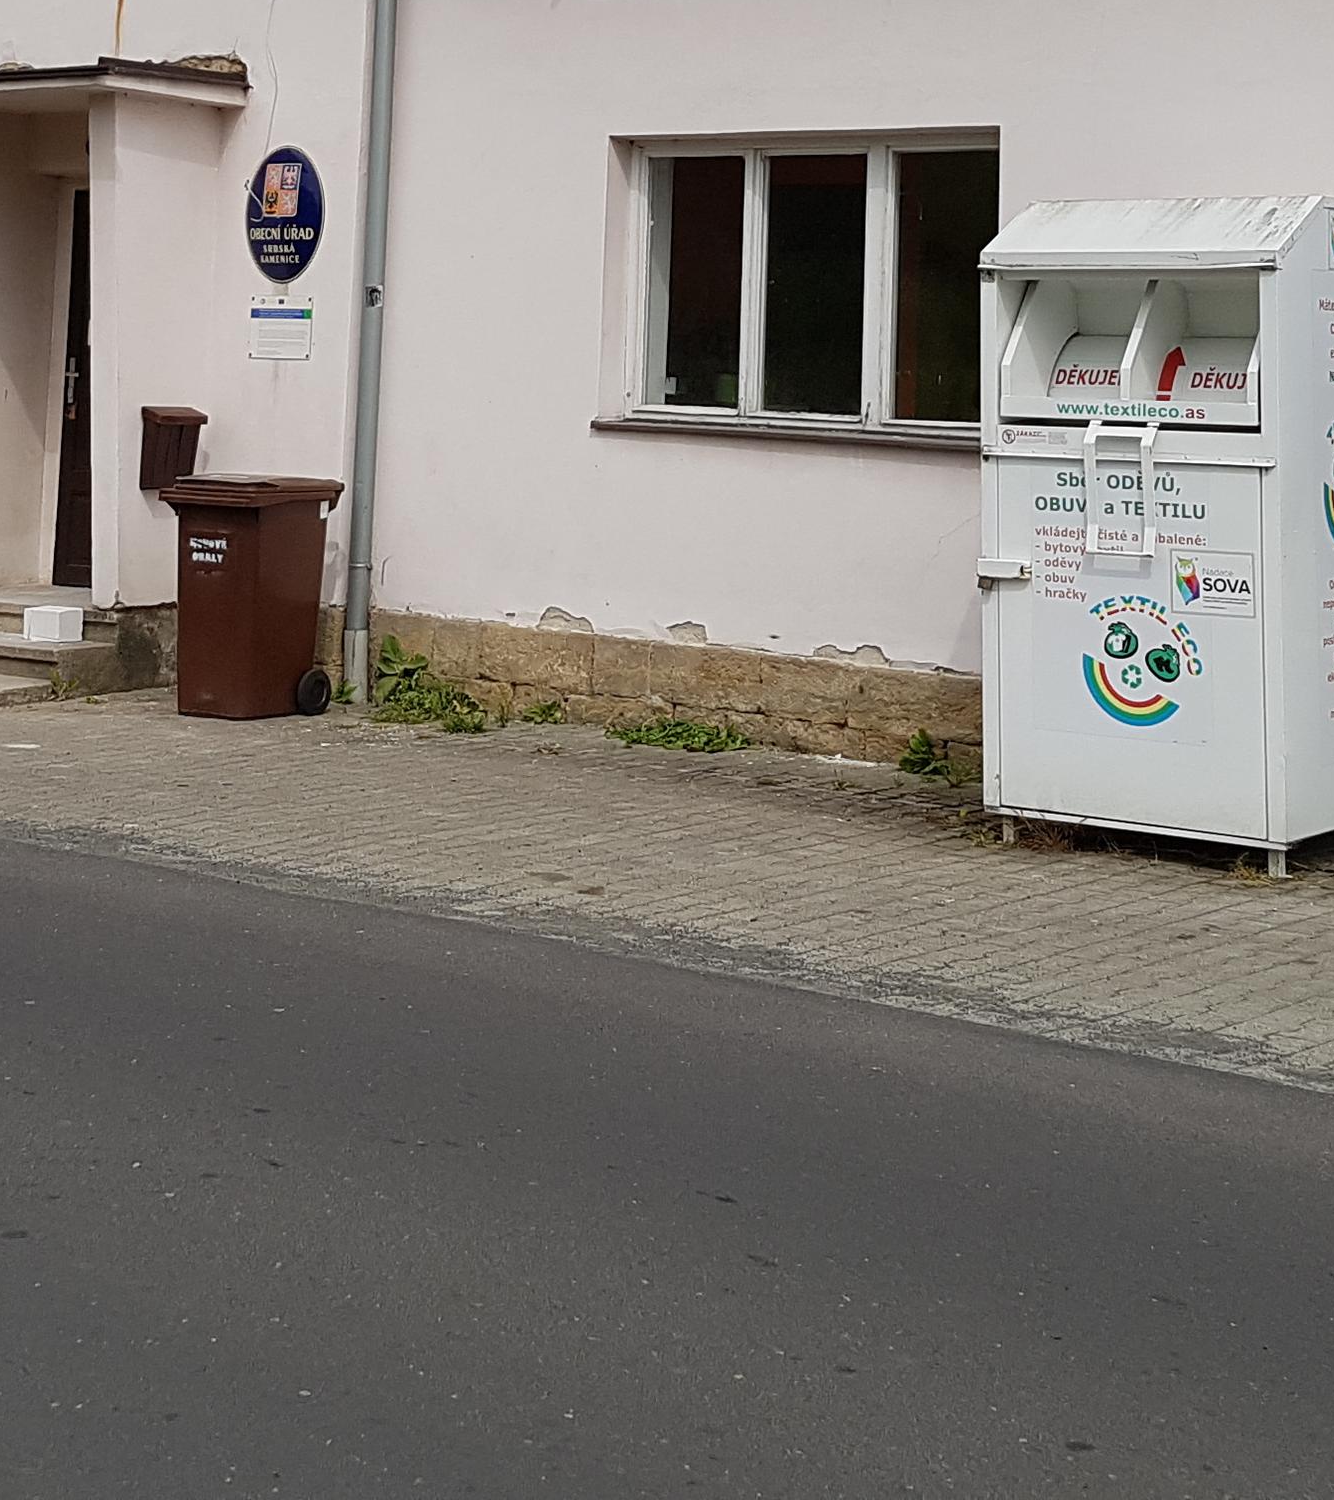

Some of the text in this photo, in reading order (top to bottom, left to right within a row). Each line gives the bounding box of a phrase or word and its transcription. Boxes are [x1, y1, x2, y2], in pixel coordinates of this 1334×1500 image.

[250, 224, 315, 240] OBECNÍ ÚŘAD
[1055, 364, 1248, 390] DĚKUJE DĚKUJ
[1057, 403, 1206, 419] www.textileco.as
[1035, 496, 1206, 519] OBUV a TETILU
[1035, 526, 1087, 539] vkládejt
[1155, 532, 1207, 547] balené:
[1044, 557, 1082, 571] oděvy
[1044, 571, 1075, 584] obuv
[1202, 577, 1251, 594] SOVA
[1045, 586, 1087, 602] hračky
[1089, 595, 1168, 626] TEXTIL
[1171, 621, 1203, 676] ECO
